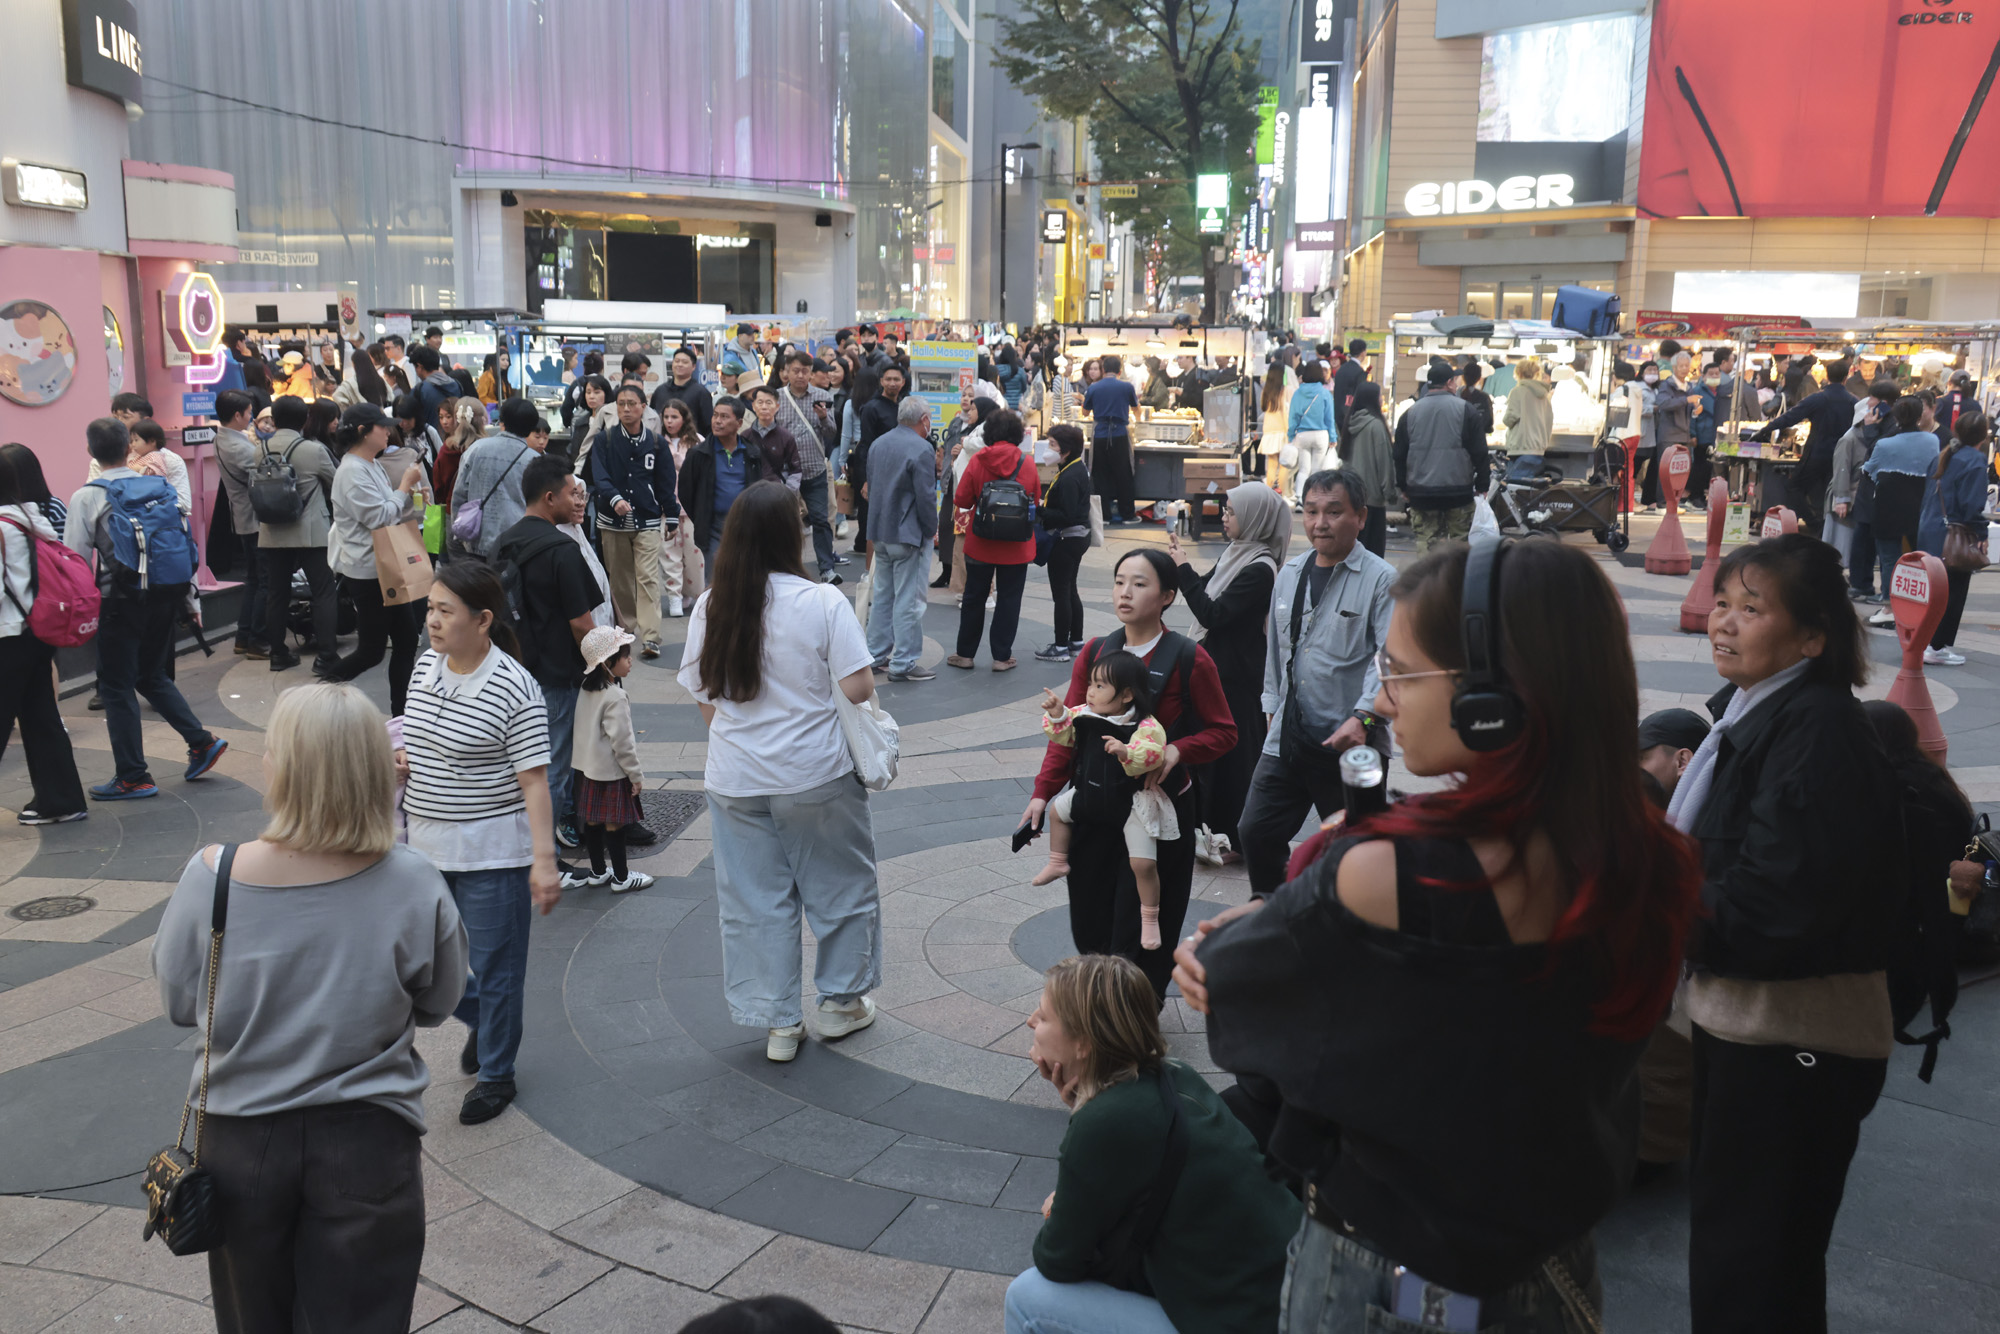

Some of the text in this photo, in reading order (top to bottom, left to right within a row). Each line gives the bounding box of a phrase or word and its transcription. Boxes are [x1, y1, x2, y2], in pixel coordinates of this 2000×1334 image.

[1897, 12, 1974, 26] EIDER
[1404, 173, 1574, 217] EIDER
[1301, 230, 1334, 242] ETUDE
[188, 430, 209, 440] ONE WAY
[645, 453, 655, 469] G
[1895, 575, 1927, 599] 주차금지
